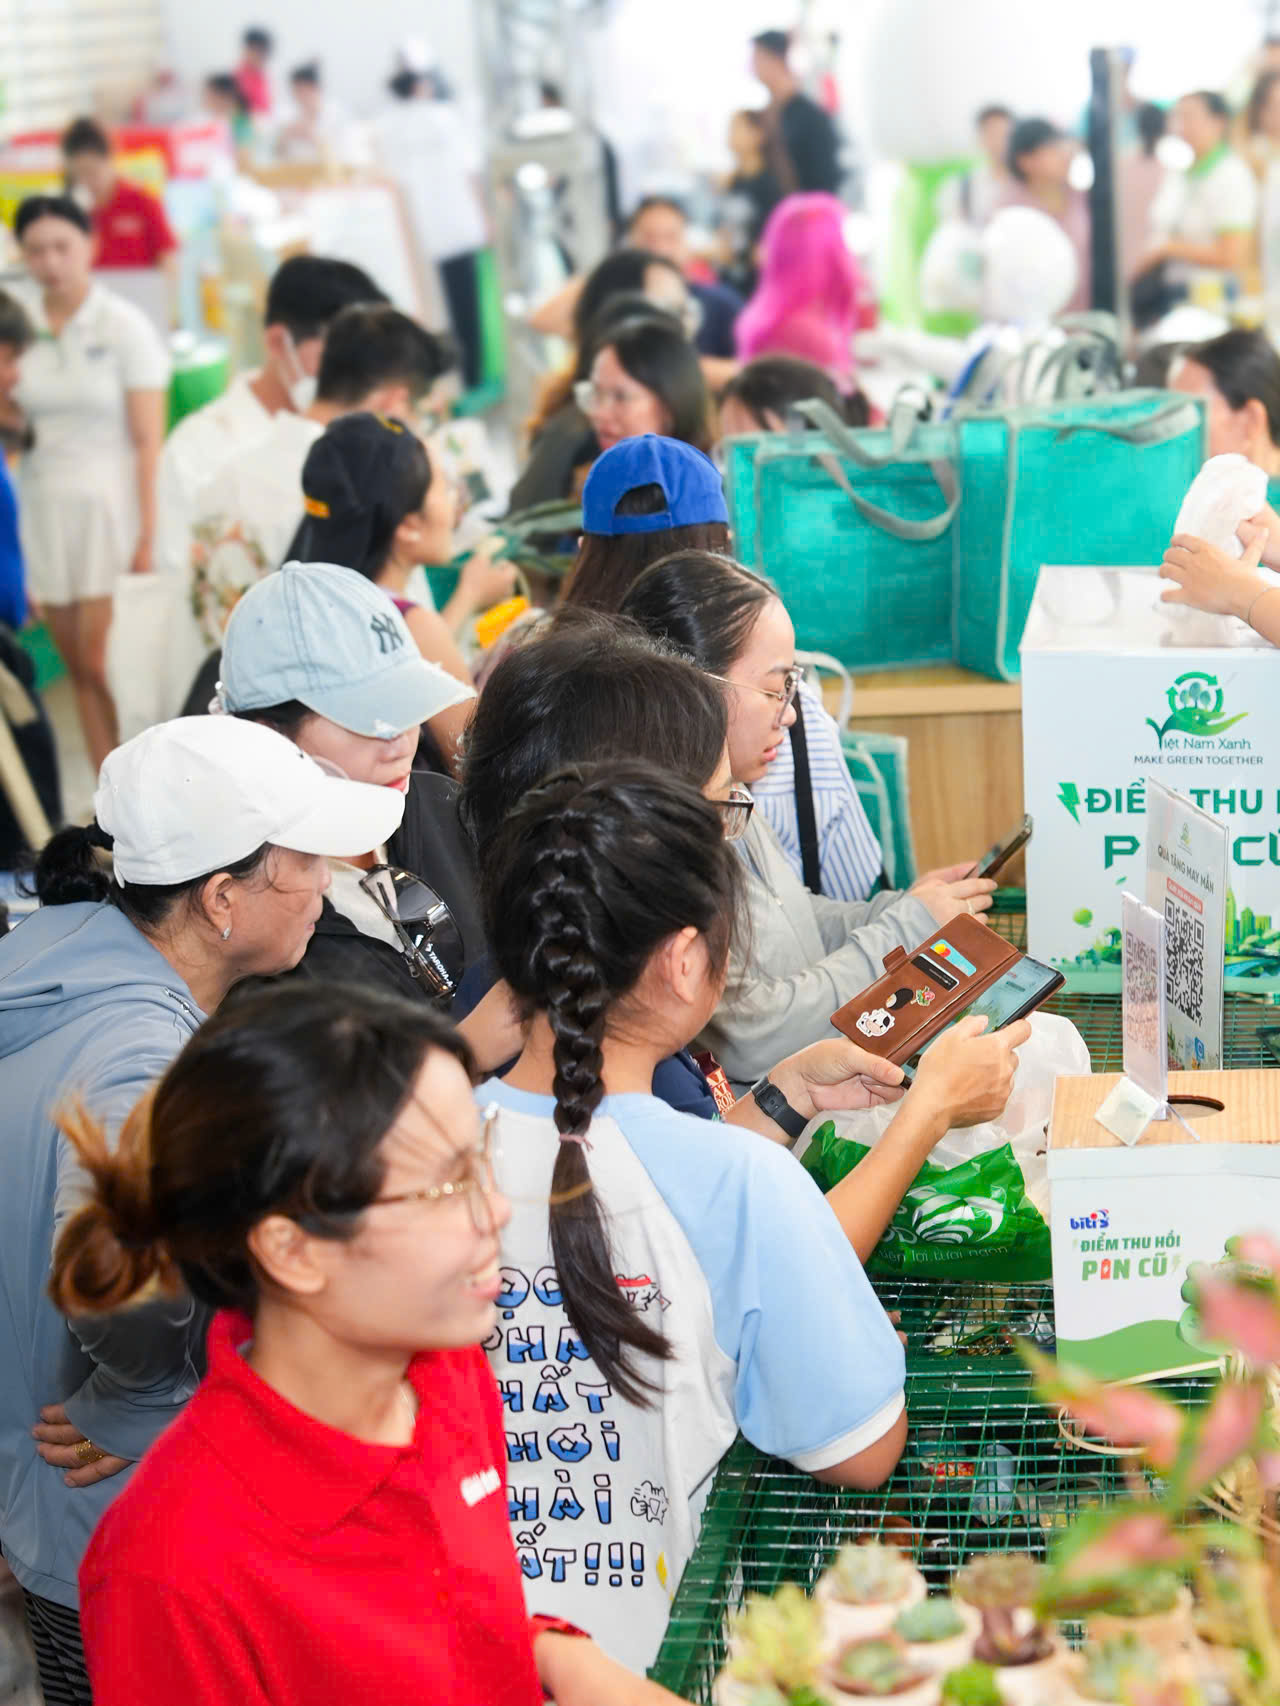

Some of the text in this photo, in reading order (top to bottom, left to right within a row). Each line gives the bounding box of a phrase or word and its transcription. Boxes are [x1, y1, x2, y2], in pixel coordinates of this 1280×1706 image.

[1183, 738, 1215, 750] Nam
[1218, 738, 1252, 750] Xanh
[1134, 755, 1264, 765] MAKE GREEN TOGETHER
[1084, 777, 1146, 814] ĐIỂ
[1190, 789, 1263, 814] THU
[1081, 1229, 1181, 1252] ĐIỂM THU HỒI
[1138, 1251, 1168, 1277] CŨ
